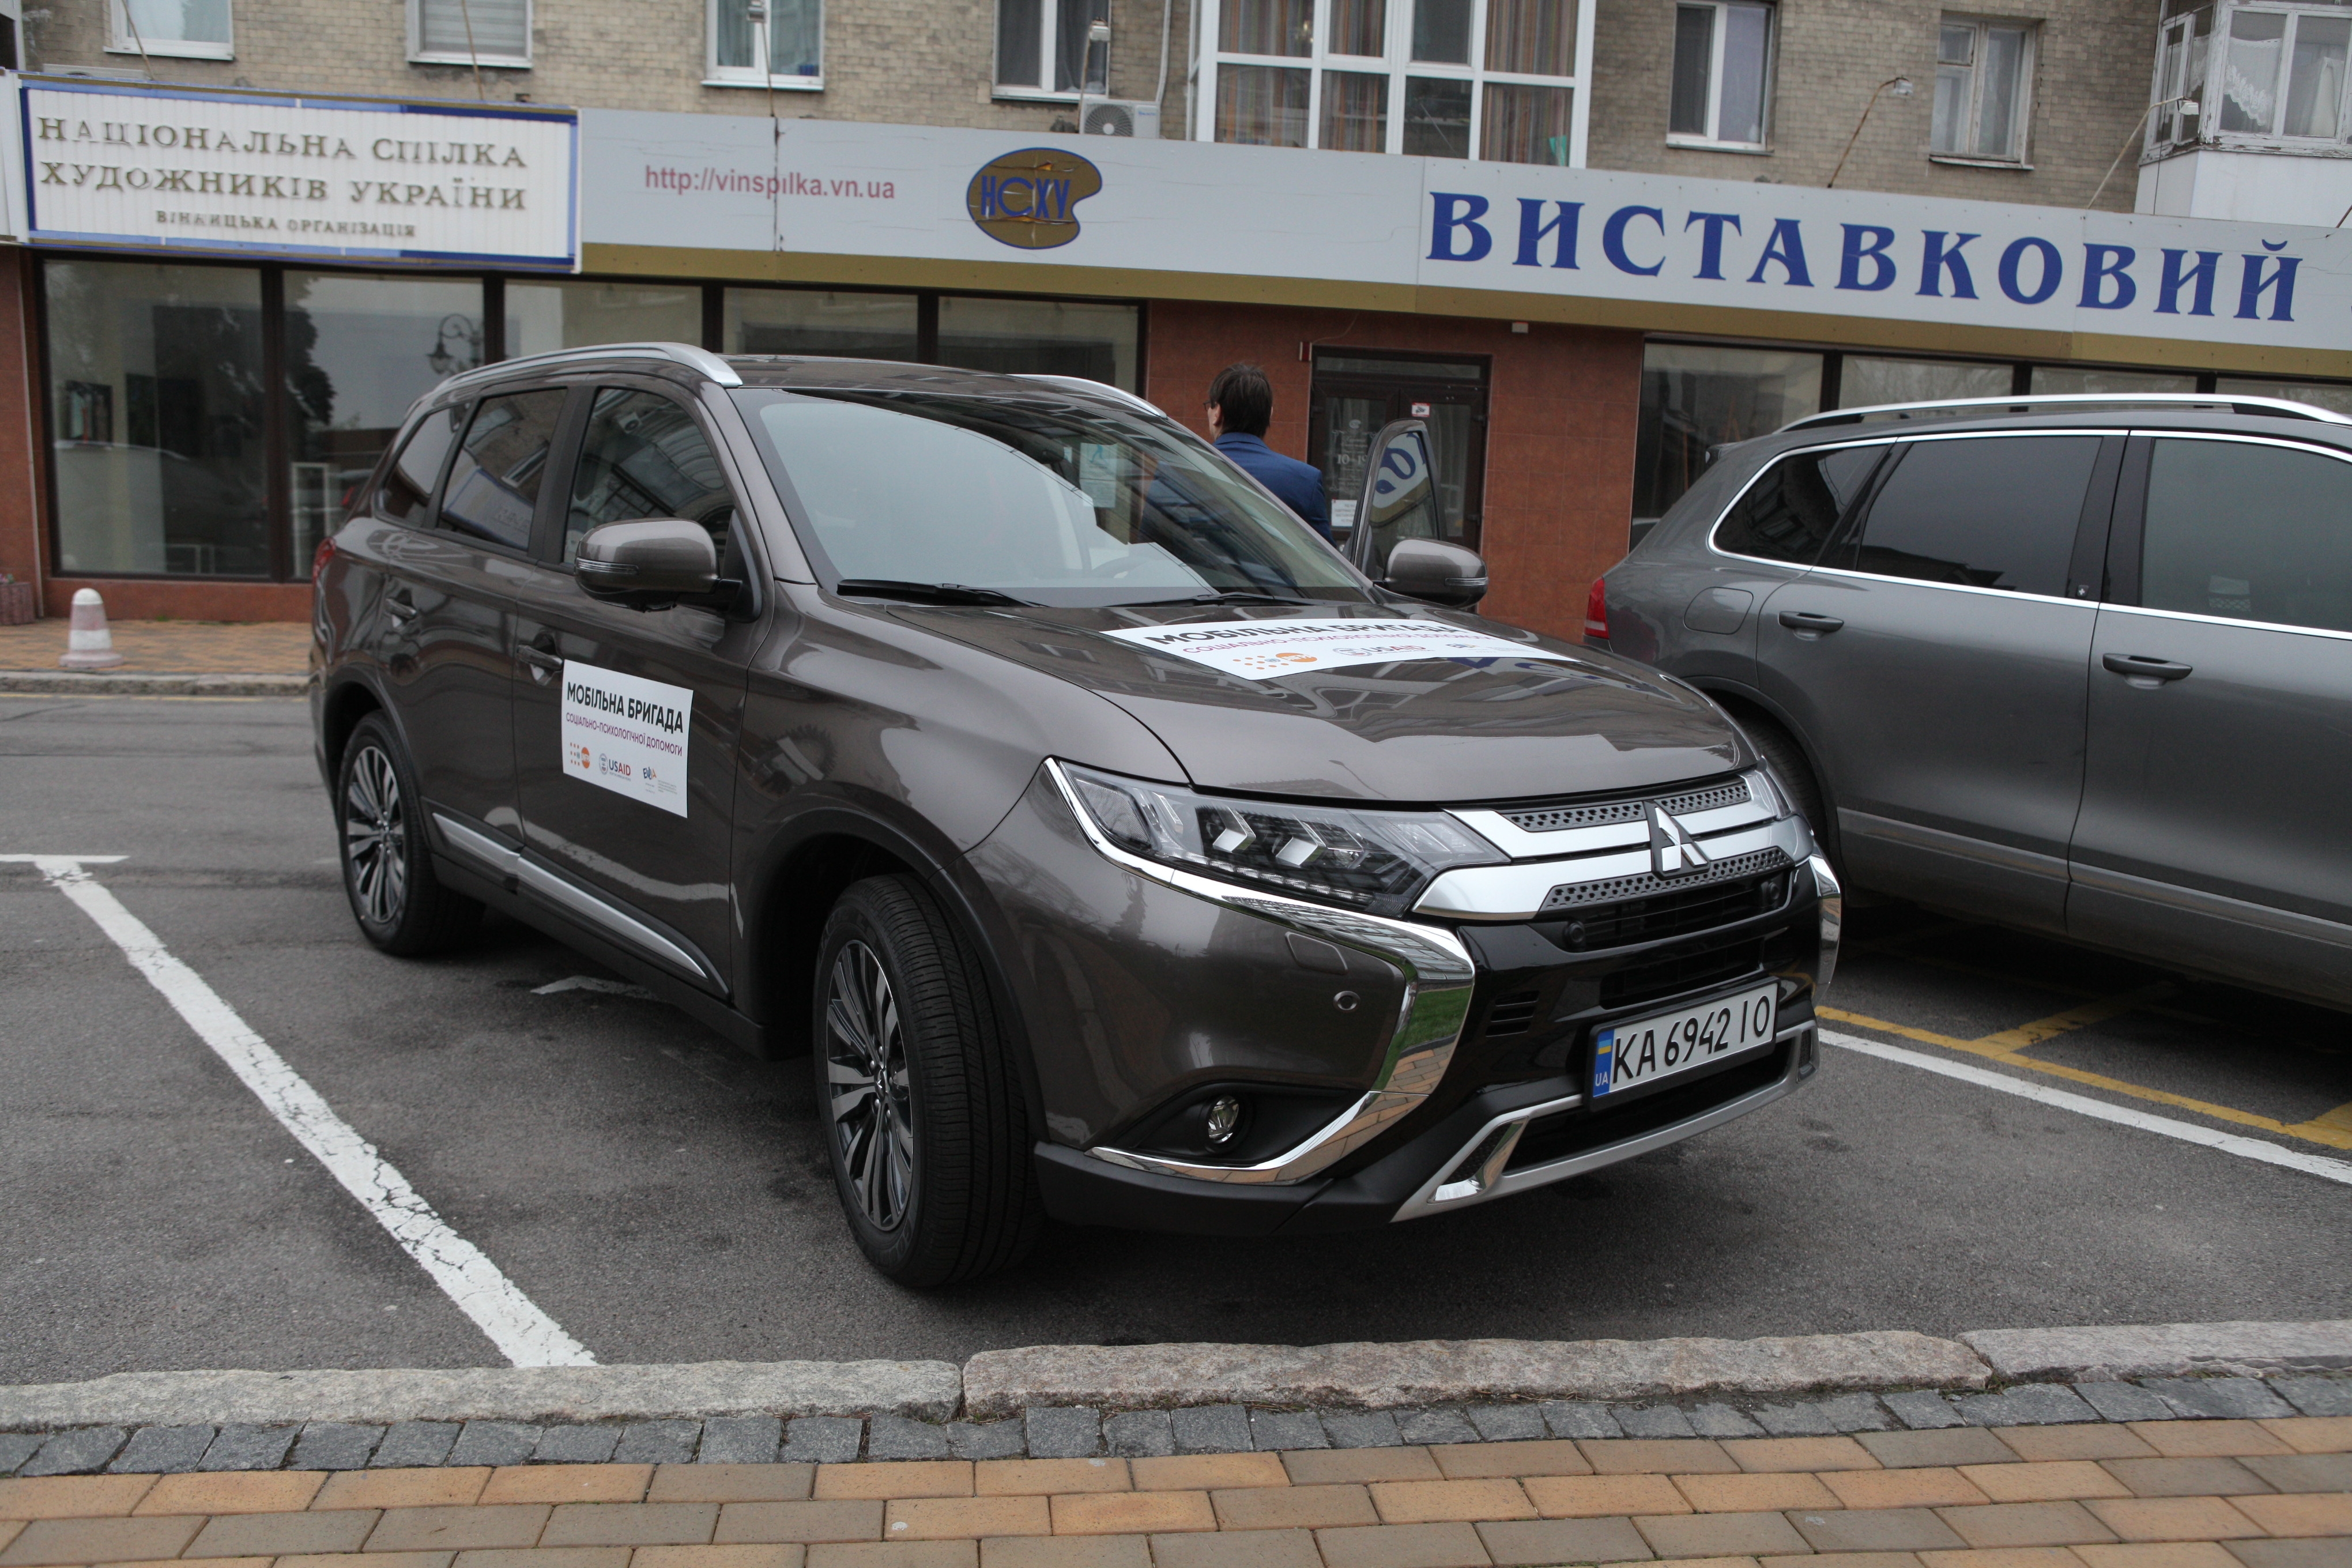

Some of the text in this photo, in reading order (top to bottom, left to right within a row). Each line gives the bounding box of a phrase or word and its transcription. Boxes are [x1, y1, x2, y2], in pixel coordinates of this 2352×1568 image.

[38, 117, 526, 167] НАЦІОНАЛЬНА СПІЛКА
[40, 161, 526, 210] ХУДОЖНИКІВ УКРАЇНИ
[646, 165, 895, 199] http://vinspilka.vn.ua
[287, 219, 415, 237] ОРГАНІЗАЦІЯ
[1426, 191, 2303, 321] ВИСТАВКОВИЙ
[1144, 624, 1468, 644] МОБІЛЬНА БРИГАДА
[567, 682, 684, 734] МОБІЛЬНА БРИГАДА
[566, 713, 683, 756] СОЦІАЛЬНО-ПСИХОЛОГІЧНОЇ ДОПОМОГИ
[609, 759, 631, 776] USAID
[1612, 1028, 1656, 1084] KA
[1664, 1008, 1731, 1066] 6942
[1595, 1072, 1608, 1087] UA
